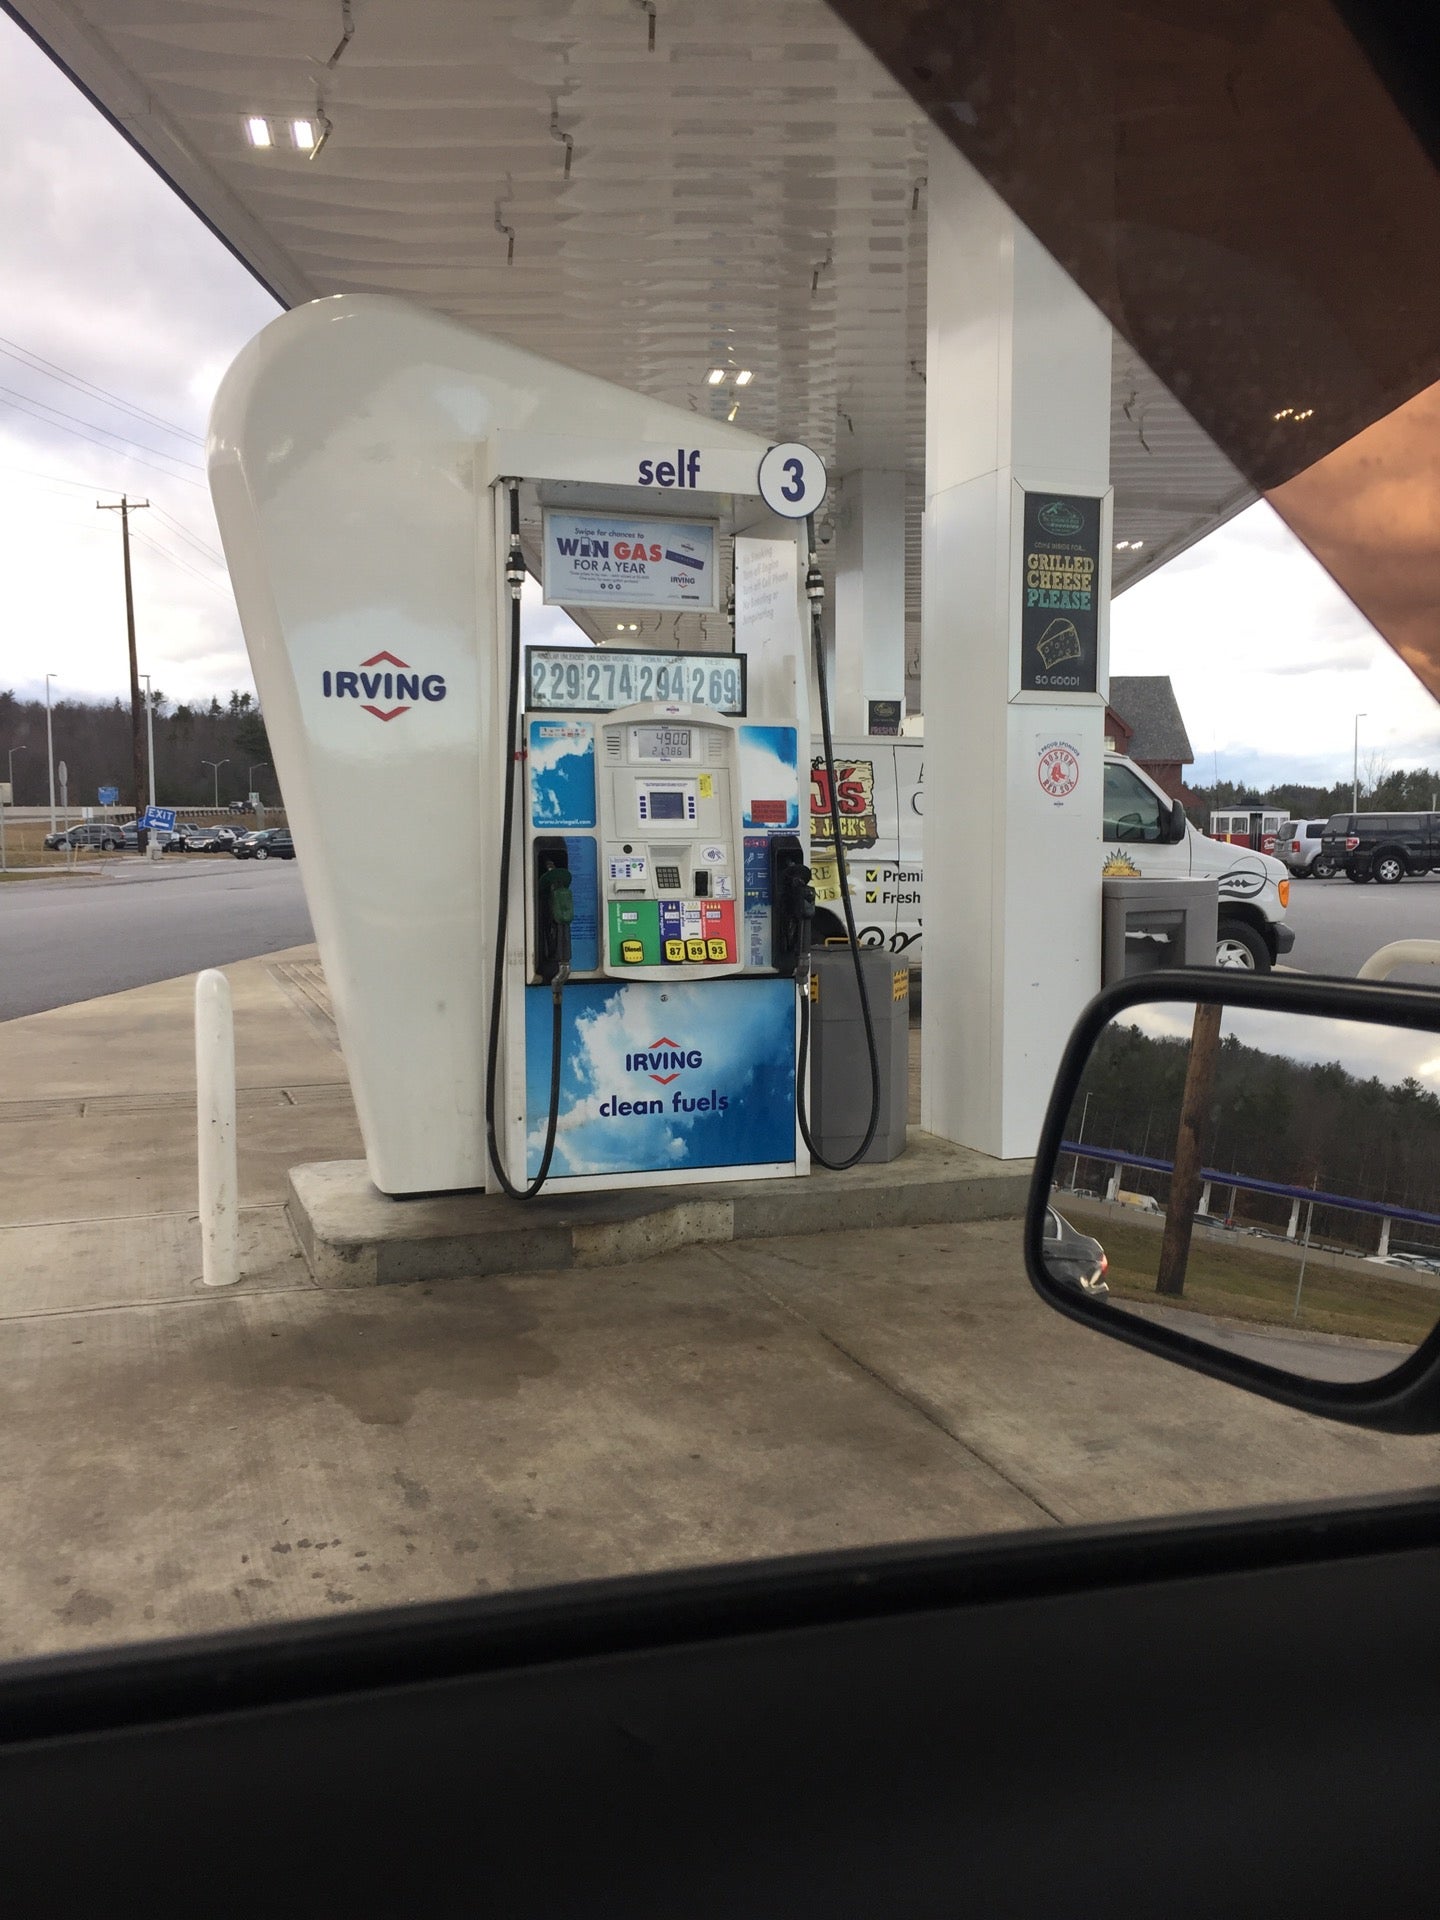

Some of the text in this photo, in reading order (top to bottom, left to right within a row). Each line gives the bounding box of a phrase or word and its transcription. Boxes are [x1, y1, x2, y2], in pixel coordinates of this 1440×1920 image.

[638, 449, 701, 488] self
[781, 458, 806, 502] 3
[575, 527, 595, 537] Swipe
[597, 529, 607, 537] for
[608, 530, 635, 538] chances
[556, 537, 663, 562] WIN GAS
[574, 559, 646, 574] FOR A YEAR
[1027, 553, 1094, 574] GRILLED
[670, 576, 695, 585] IRVING
[1027, 570, 1092, 592] CHEESE
[1027, 588, 1091, 610] PLEASE
[322, 670, 447, 701] IRVING
[1035, 675, 1080, 686] SO GOOD!
[1043, 751, 1074, 767] BOSTON
[1043, 779, 1075, 794] RED SOX
[148, 808, 174, 820] EXIT
[882, 891, 921, 904] Fresh
[669, 947, 681, 955] 87
[691, 947, 703, 955] 89
[712, 946, 724, 954] 93
[625, 1050, 702, 1072] IRVING
[599, 1090, 729, 1117] clean fuels
